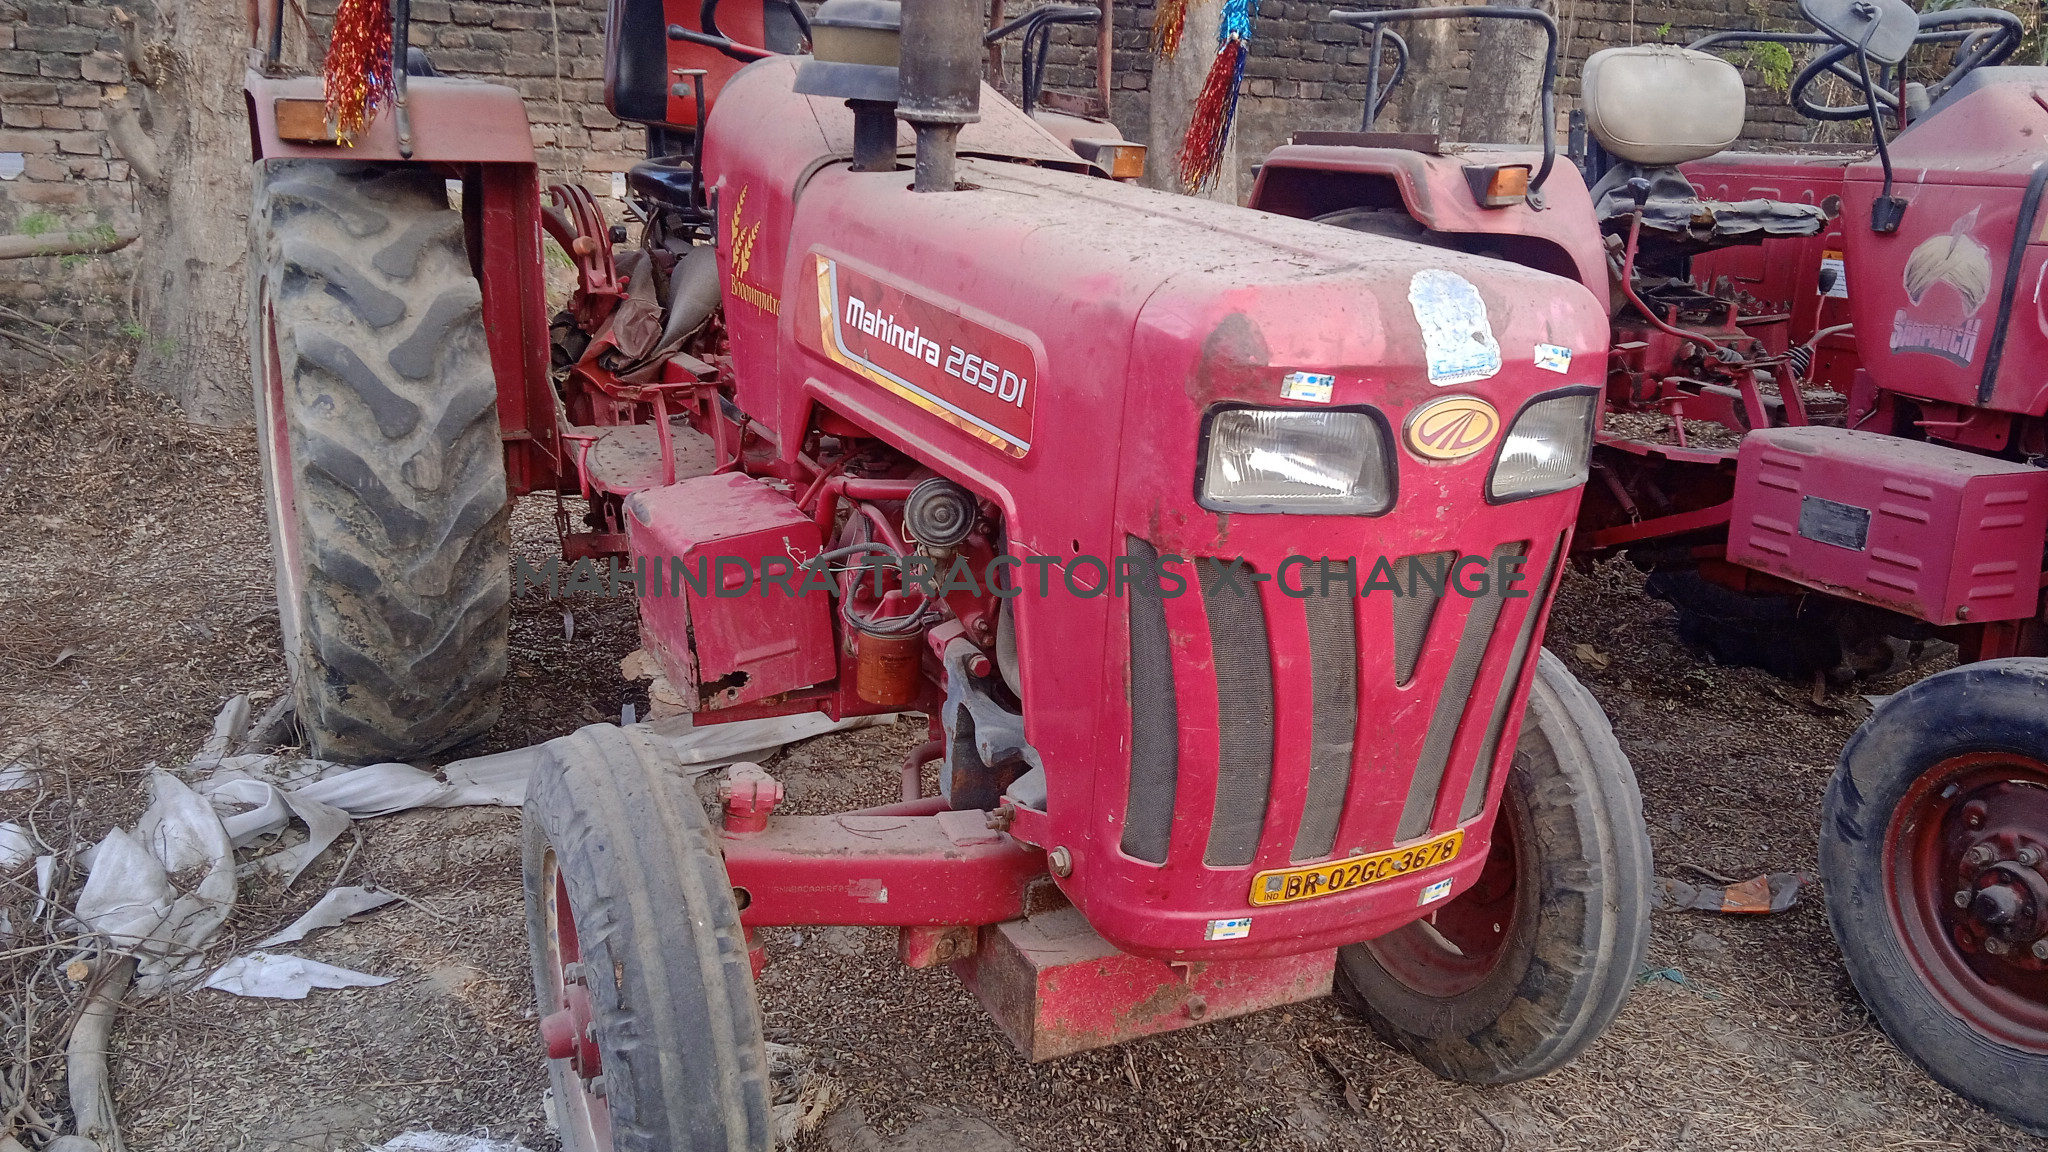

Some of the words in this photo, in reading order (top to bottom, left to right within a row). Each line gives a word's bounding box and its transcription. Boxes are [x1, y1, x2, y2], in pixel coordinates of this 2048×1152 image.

[846, 295, 941, 367] Mahindra
[1264, 893, 1279, 901] IND
[1285, 873, 1319, 899] BR
[1328, 857, 1392, 890] 02GC
[1400, 838, 1455, 871] 3678
